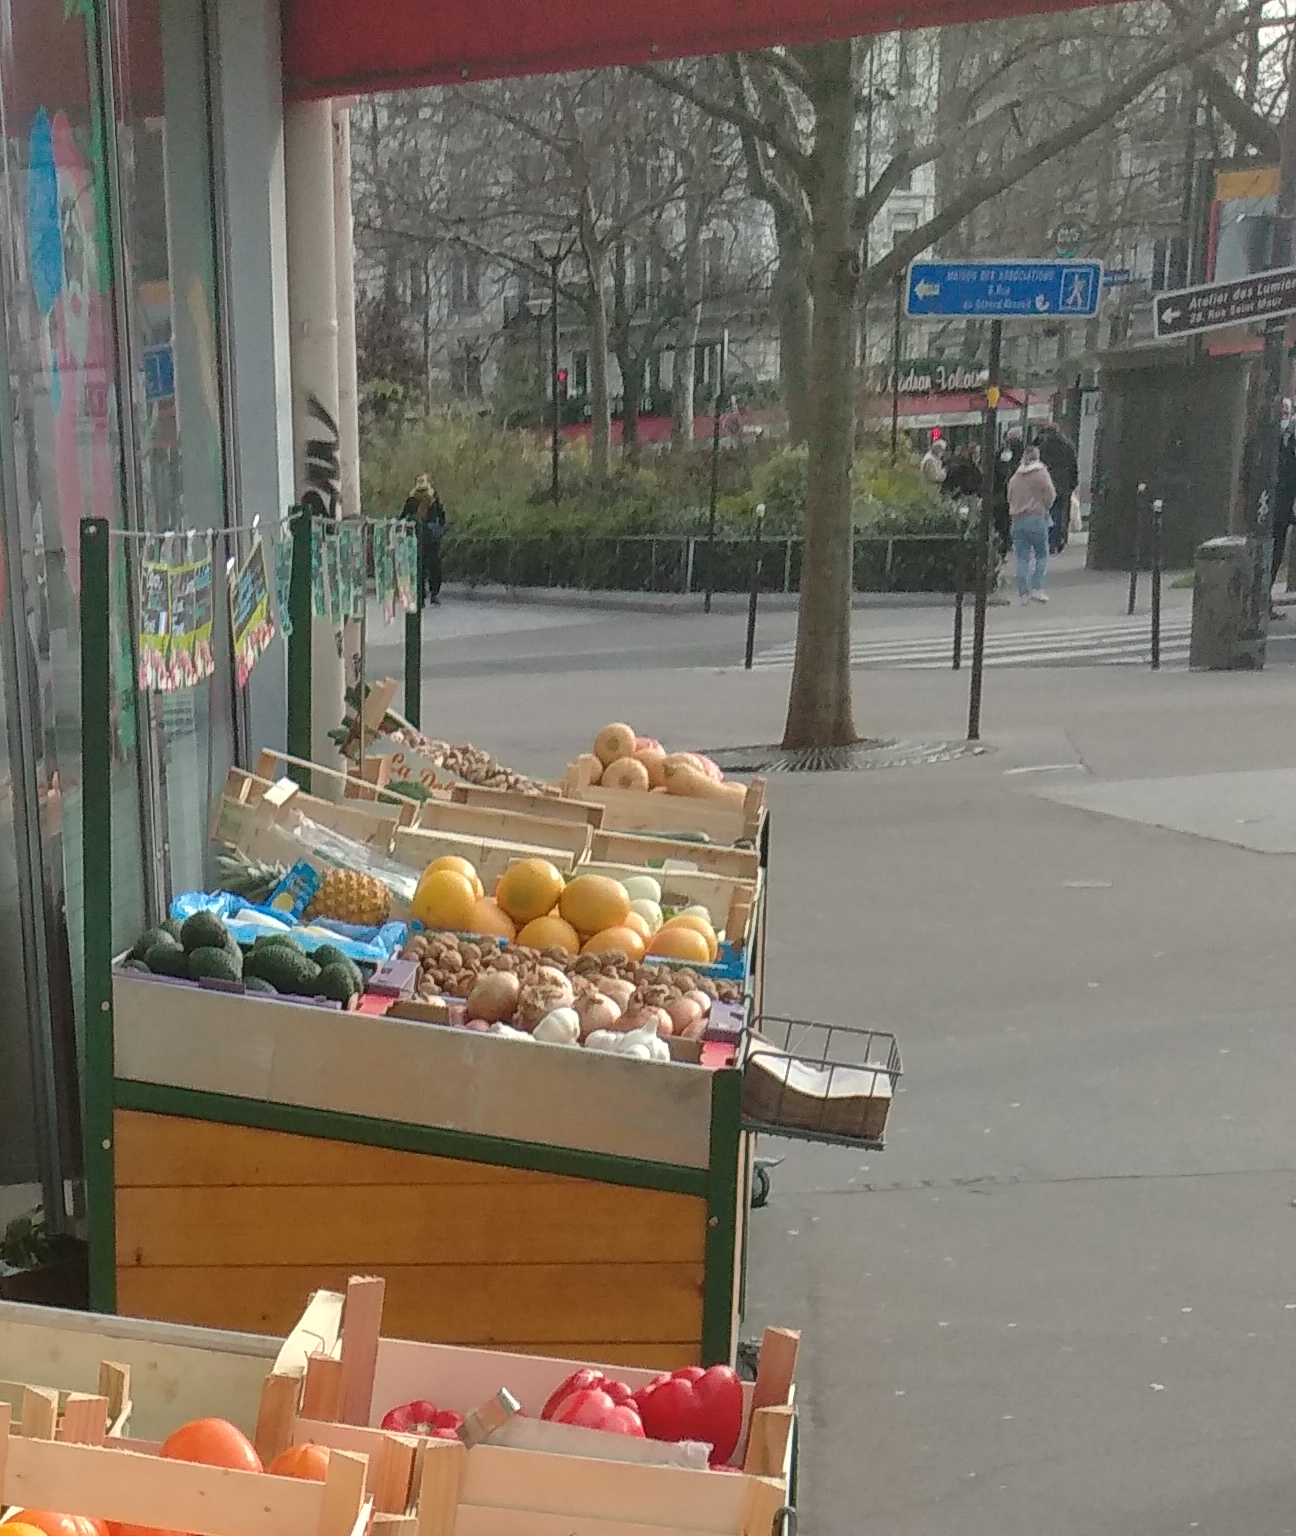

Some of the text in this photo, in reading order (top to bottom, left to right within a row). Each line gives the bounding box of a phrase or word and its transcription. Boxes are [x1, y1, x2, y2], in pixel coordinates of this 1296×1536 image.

[1188, 292, 1229, 310] Atelier
[1233, 286, 1253, 301] des
[1230, 301, 1255, 316] Saint
